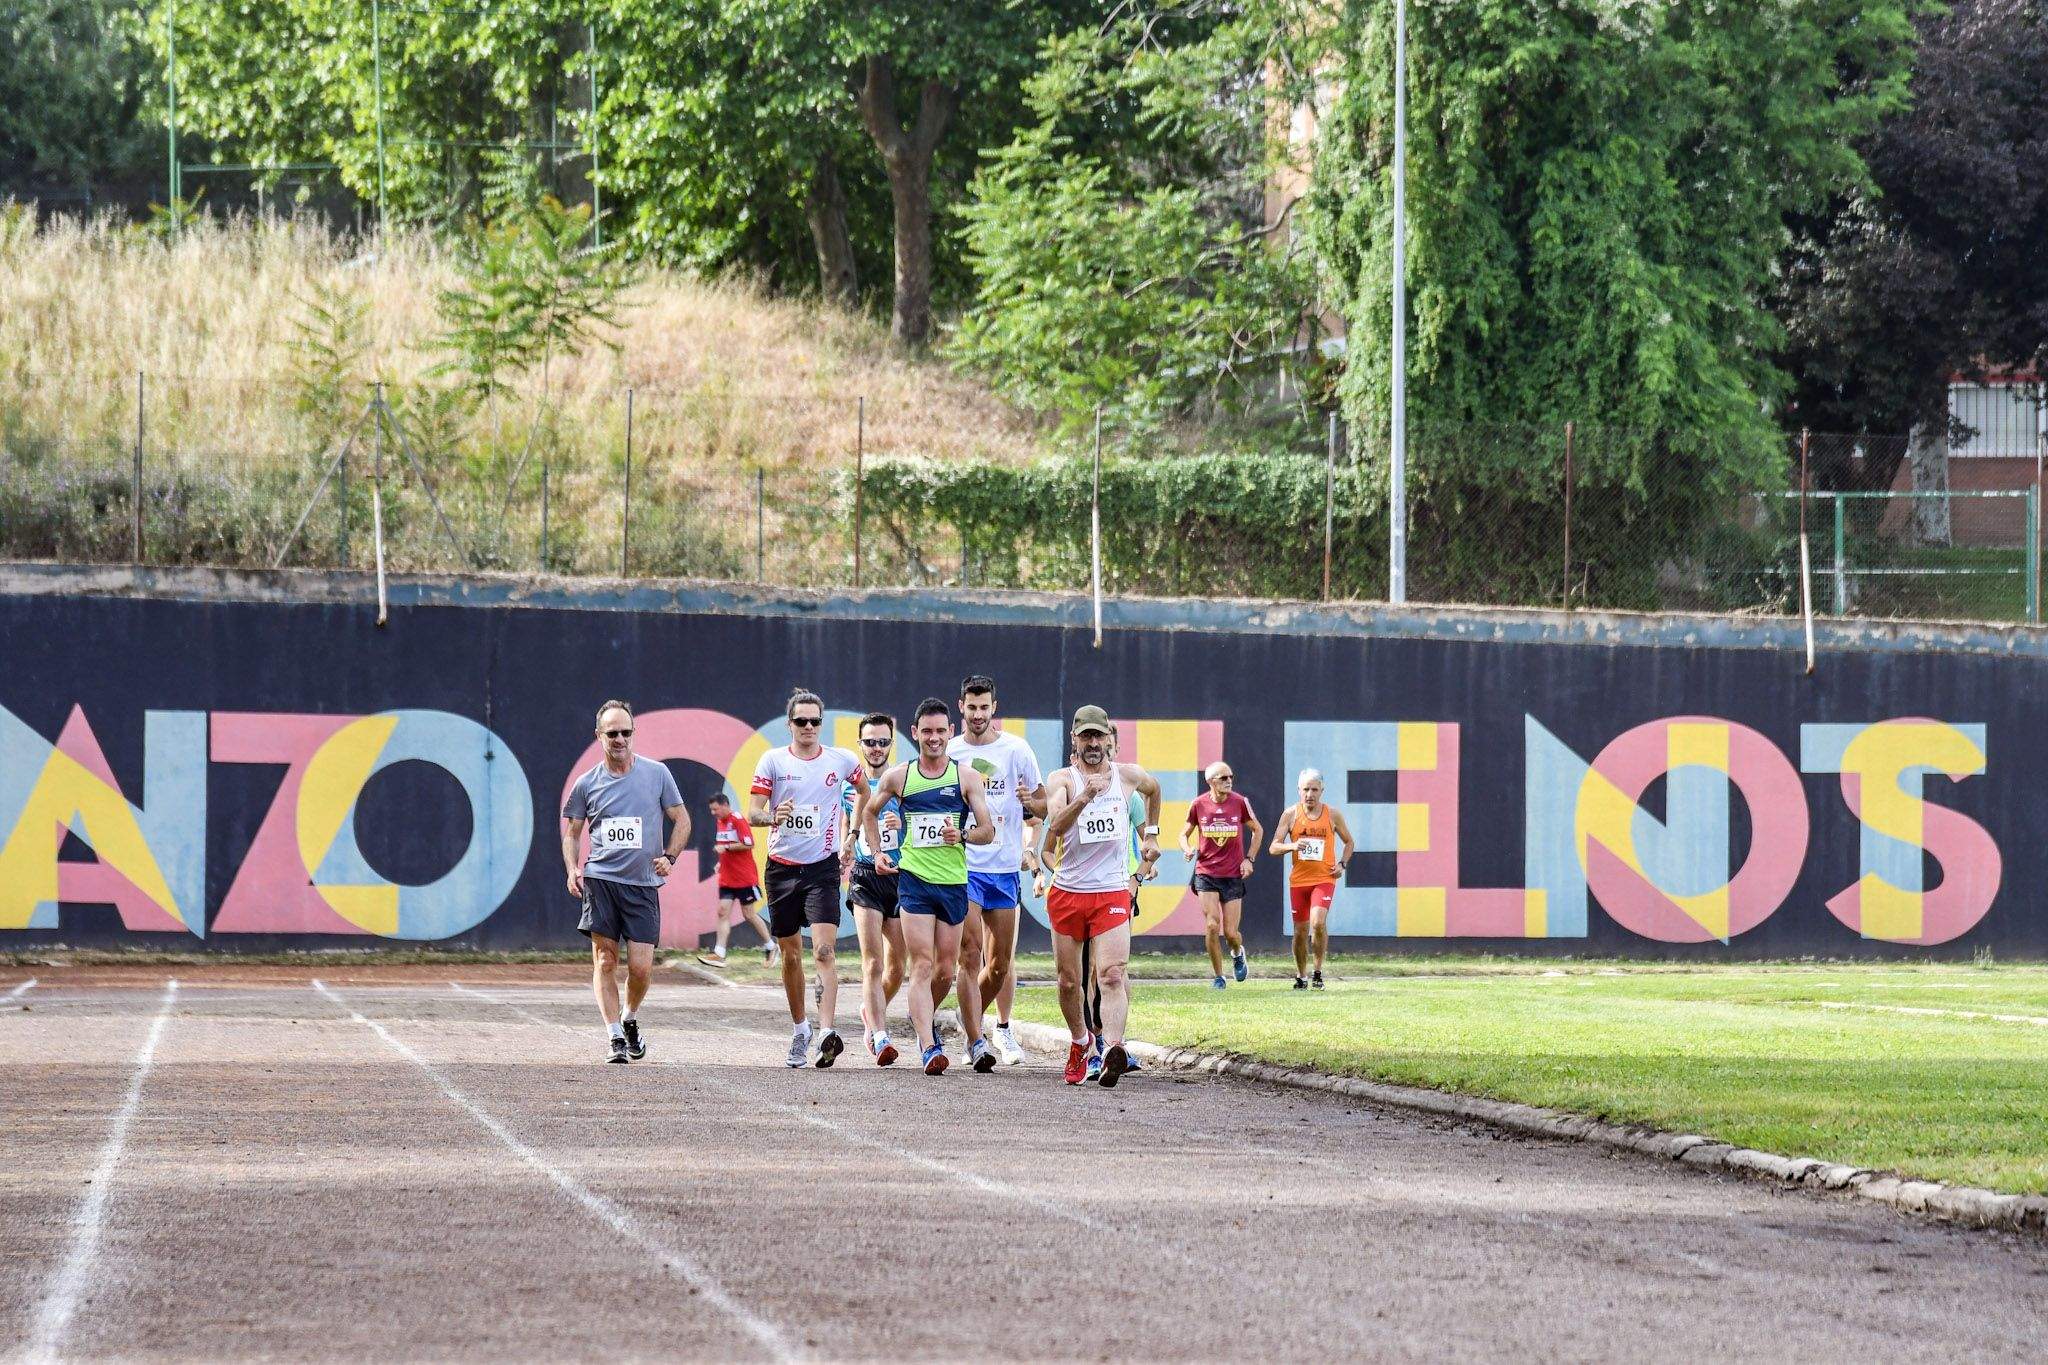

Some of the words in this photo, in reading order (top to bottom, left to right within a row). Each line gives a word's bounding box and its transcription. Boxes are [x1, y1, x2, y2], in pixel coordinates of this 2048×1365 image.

[786, 816, 813, 829] 866
[1087, 818, 1115, 834] 803
[608, 828, 634, 842] 906
